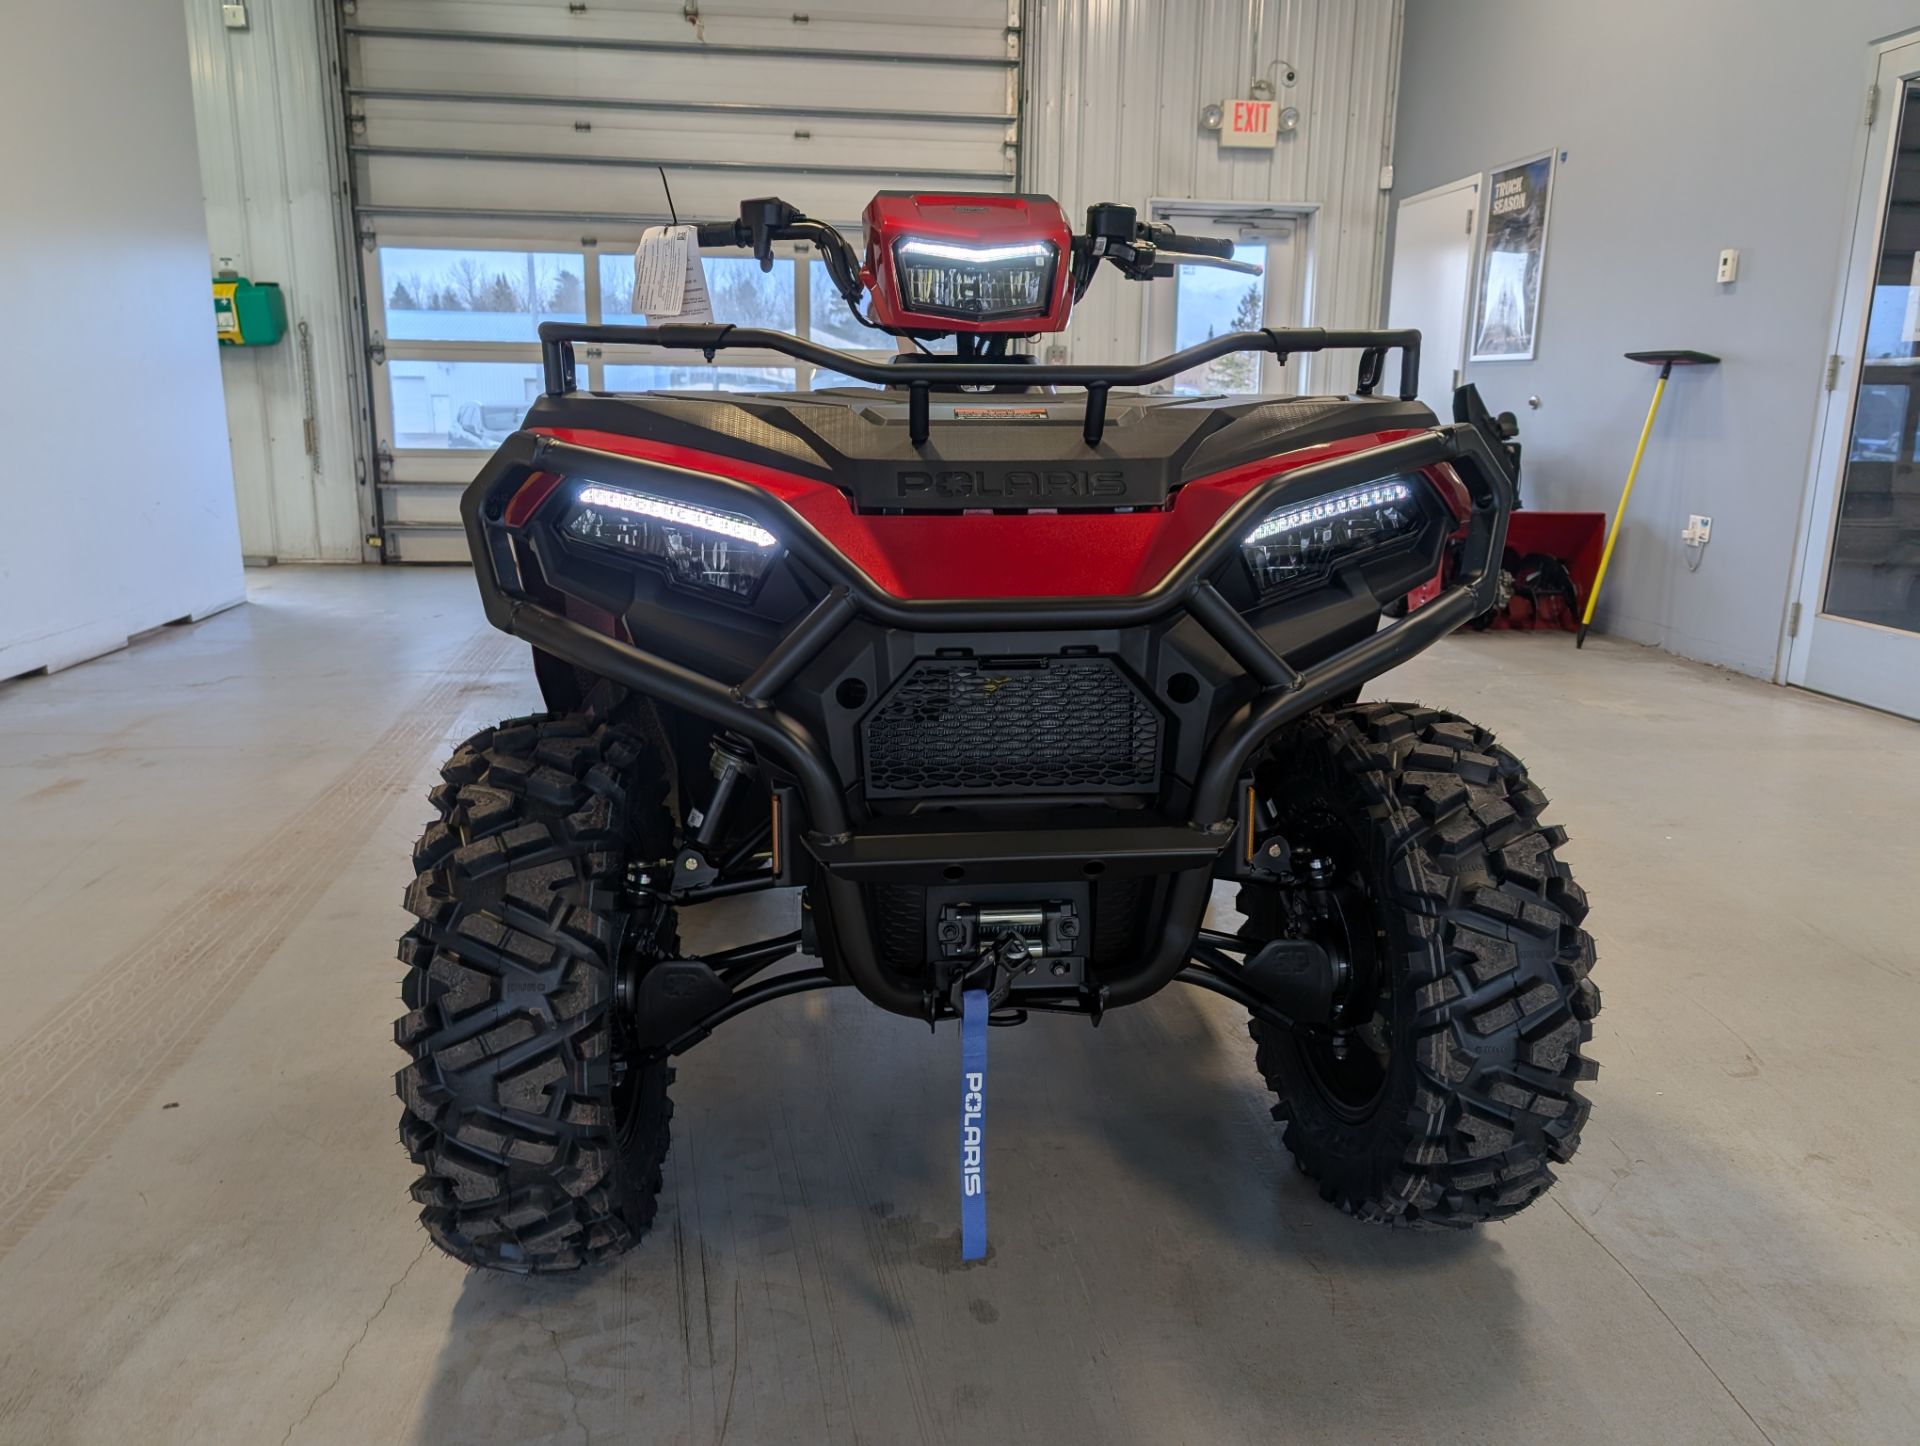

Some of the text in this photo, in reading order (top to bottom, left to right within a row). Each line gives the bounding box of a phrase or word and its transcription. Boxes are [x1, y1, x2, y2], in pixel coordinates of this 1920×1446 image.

[1233, 102, 1271, 132] EXIT
[1495, 176, 1523, 199] TRUCK
[1493, 192, 1527, 215] SEASON
[896, 471, 1127, 497] POLARIS
[964, 1072, 983, 1197] POLARIS
